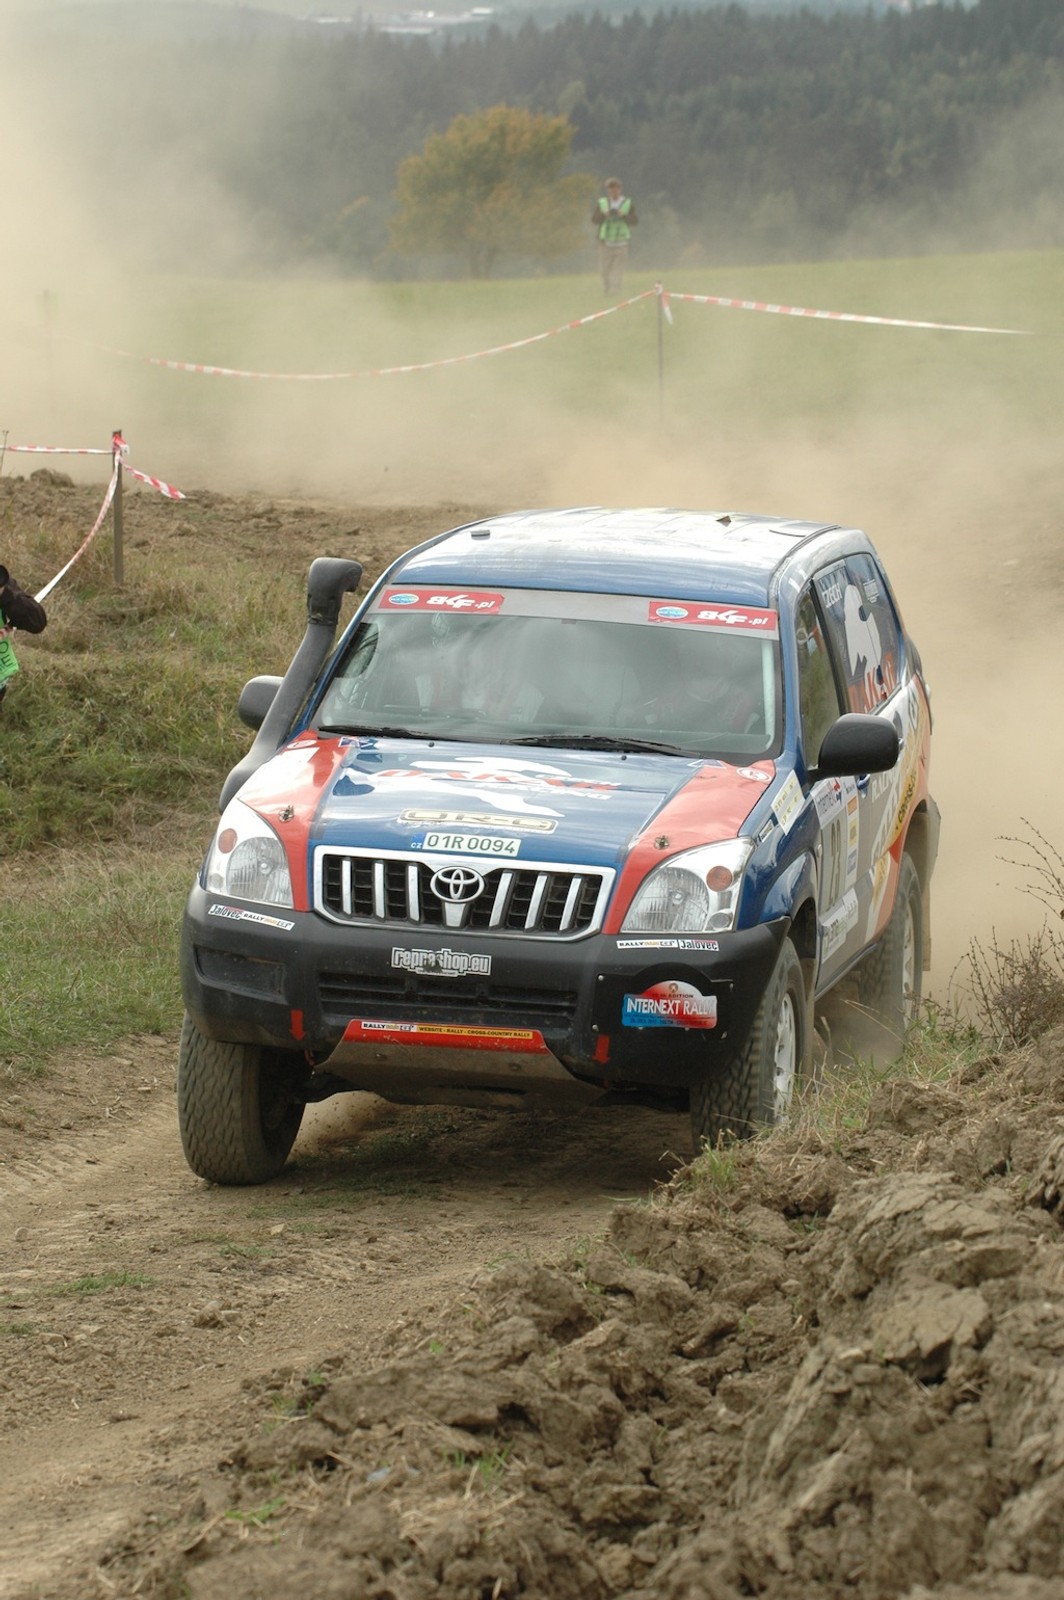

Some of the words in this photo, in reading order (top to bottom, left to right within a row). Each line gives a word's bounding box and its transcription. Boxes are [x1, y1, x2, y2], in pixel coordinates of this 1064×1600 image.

[467, 837, 516, 854] 0094
[210, 904, 242, 919] Jalovec
[680, 940, 718, 950] Jalovec
[626, 998, 681, 1015] INTERNEXT
[683, 1000, 715, 1016] RALLY
[467, 1029, 513, 1037] CROSS-COUNTRY
